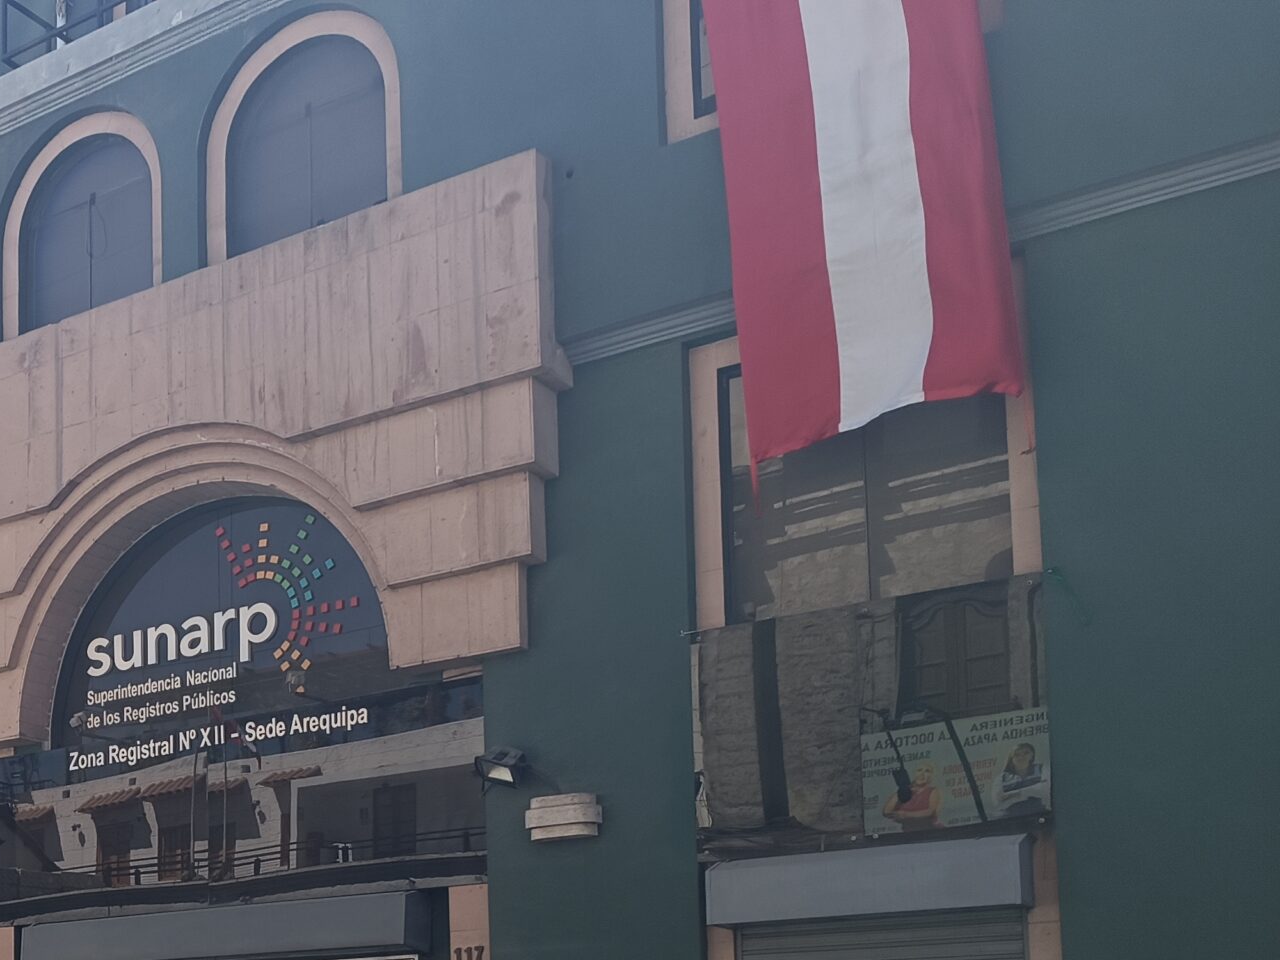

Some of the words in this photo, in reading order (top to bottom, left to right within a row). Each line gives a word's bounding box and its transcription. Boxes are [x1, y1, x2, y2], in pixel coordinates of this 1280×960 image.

[87, 602, 277, 678] sunarp
[87, 673, 181, 706] Superintendencia
[186, 661, 237, 687] Nacional
[87, 713, 101, 729] de
[103, 709, 120, 727] los
[123, 699, 179, 724] Registros
[182, 689, 236, 711] Públicos
[69, 751, 104, 771] Zona
[108, 734, 174, 766] Registral
[245, 715, 286, 742] Sede
[290, 706, 368, 735] Arequipa
